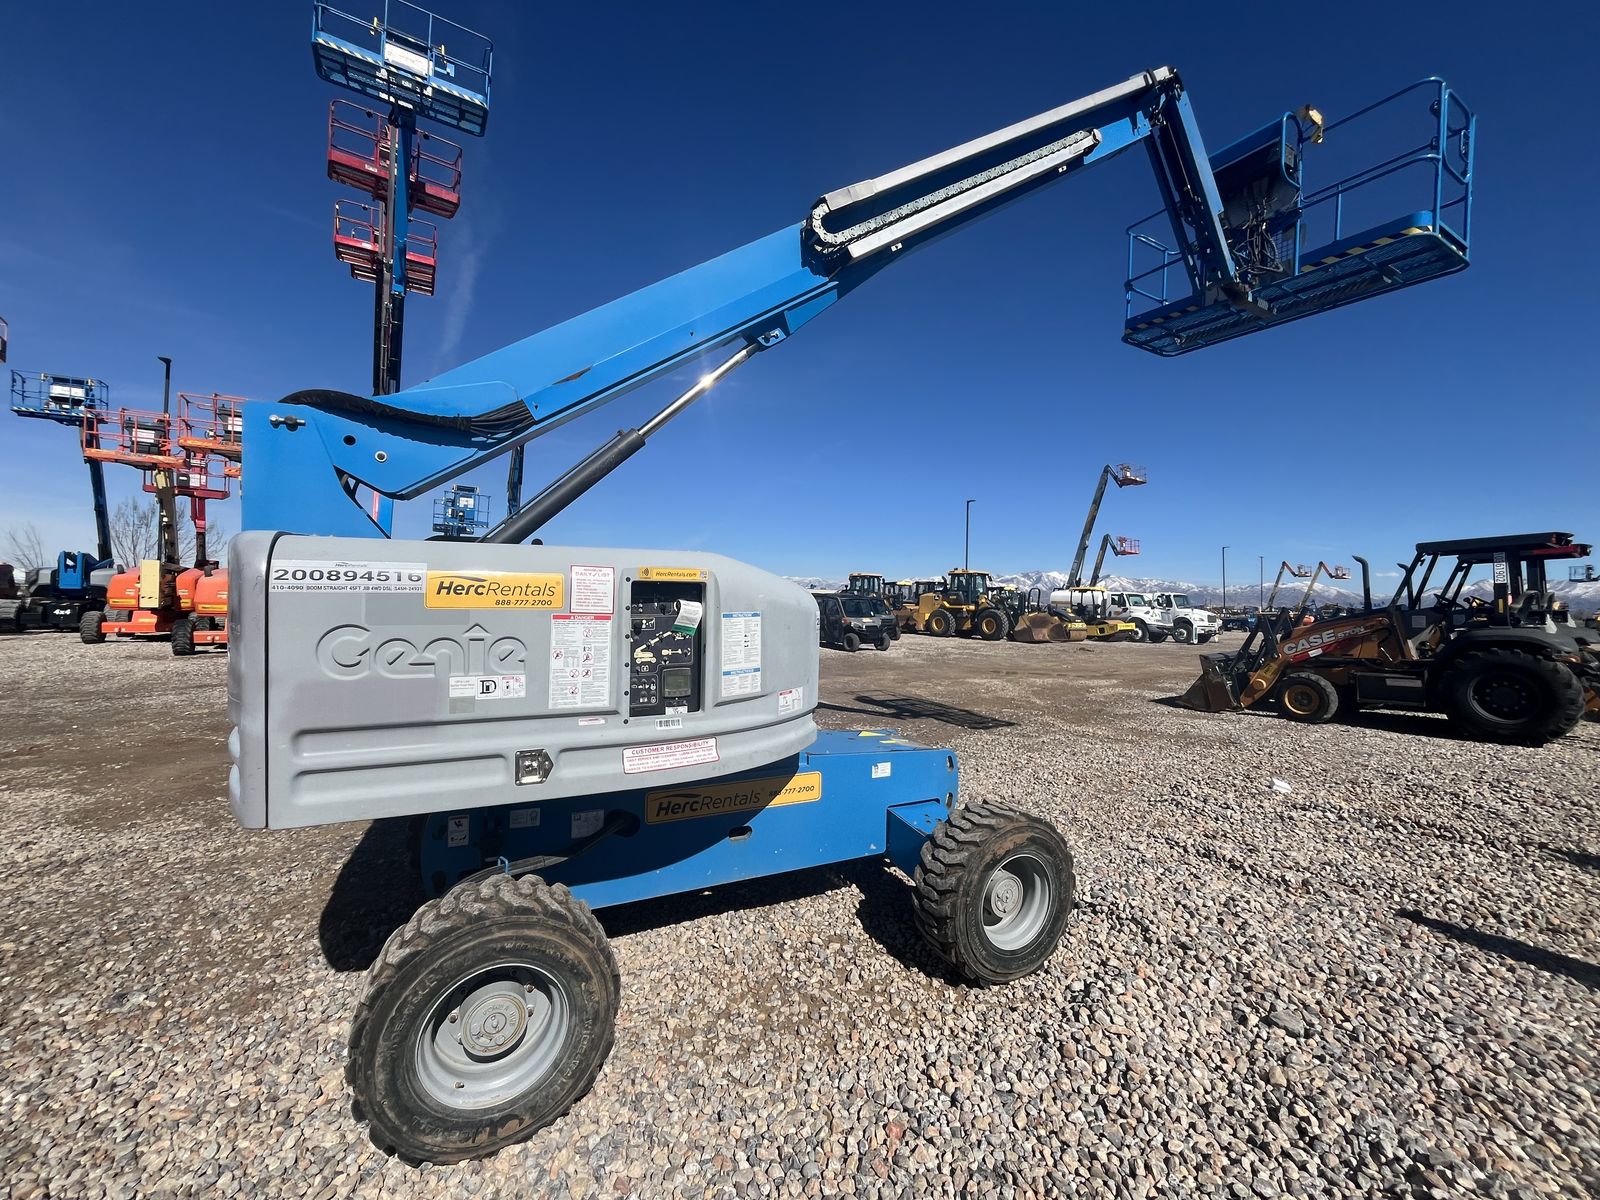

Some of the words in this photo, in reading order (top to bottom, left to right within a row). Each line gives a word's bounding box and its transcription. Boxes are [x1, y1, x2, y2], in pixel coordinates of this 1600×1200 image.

[273, 568, 422, 582] 200894516
[436, 580, 556, 597] HercRentals
[1283, 629, 1336, 655] CASE
[631, 746, 665, 755] CUSTOMER
[665, 741, 709, 752] RESPONSIBILITY
[655, 789, 761, 817] HercRentals
